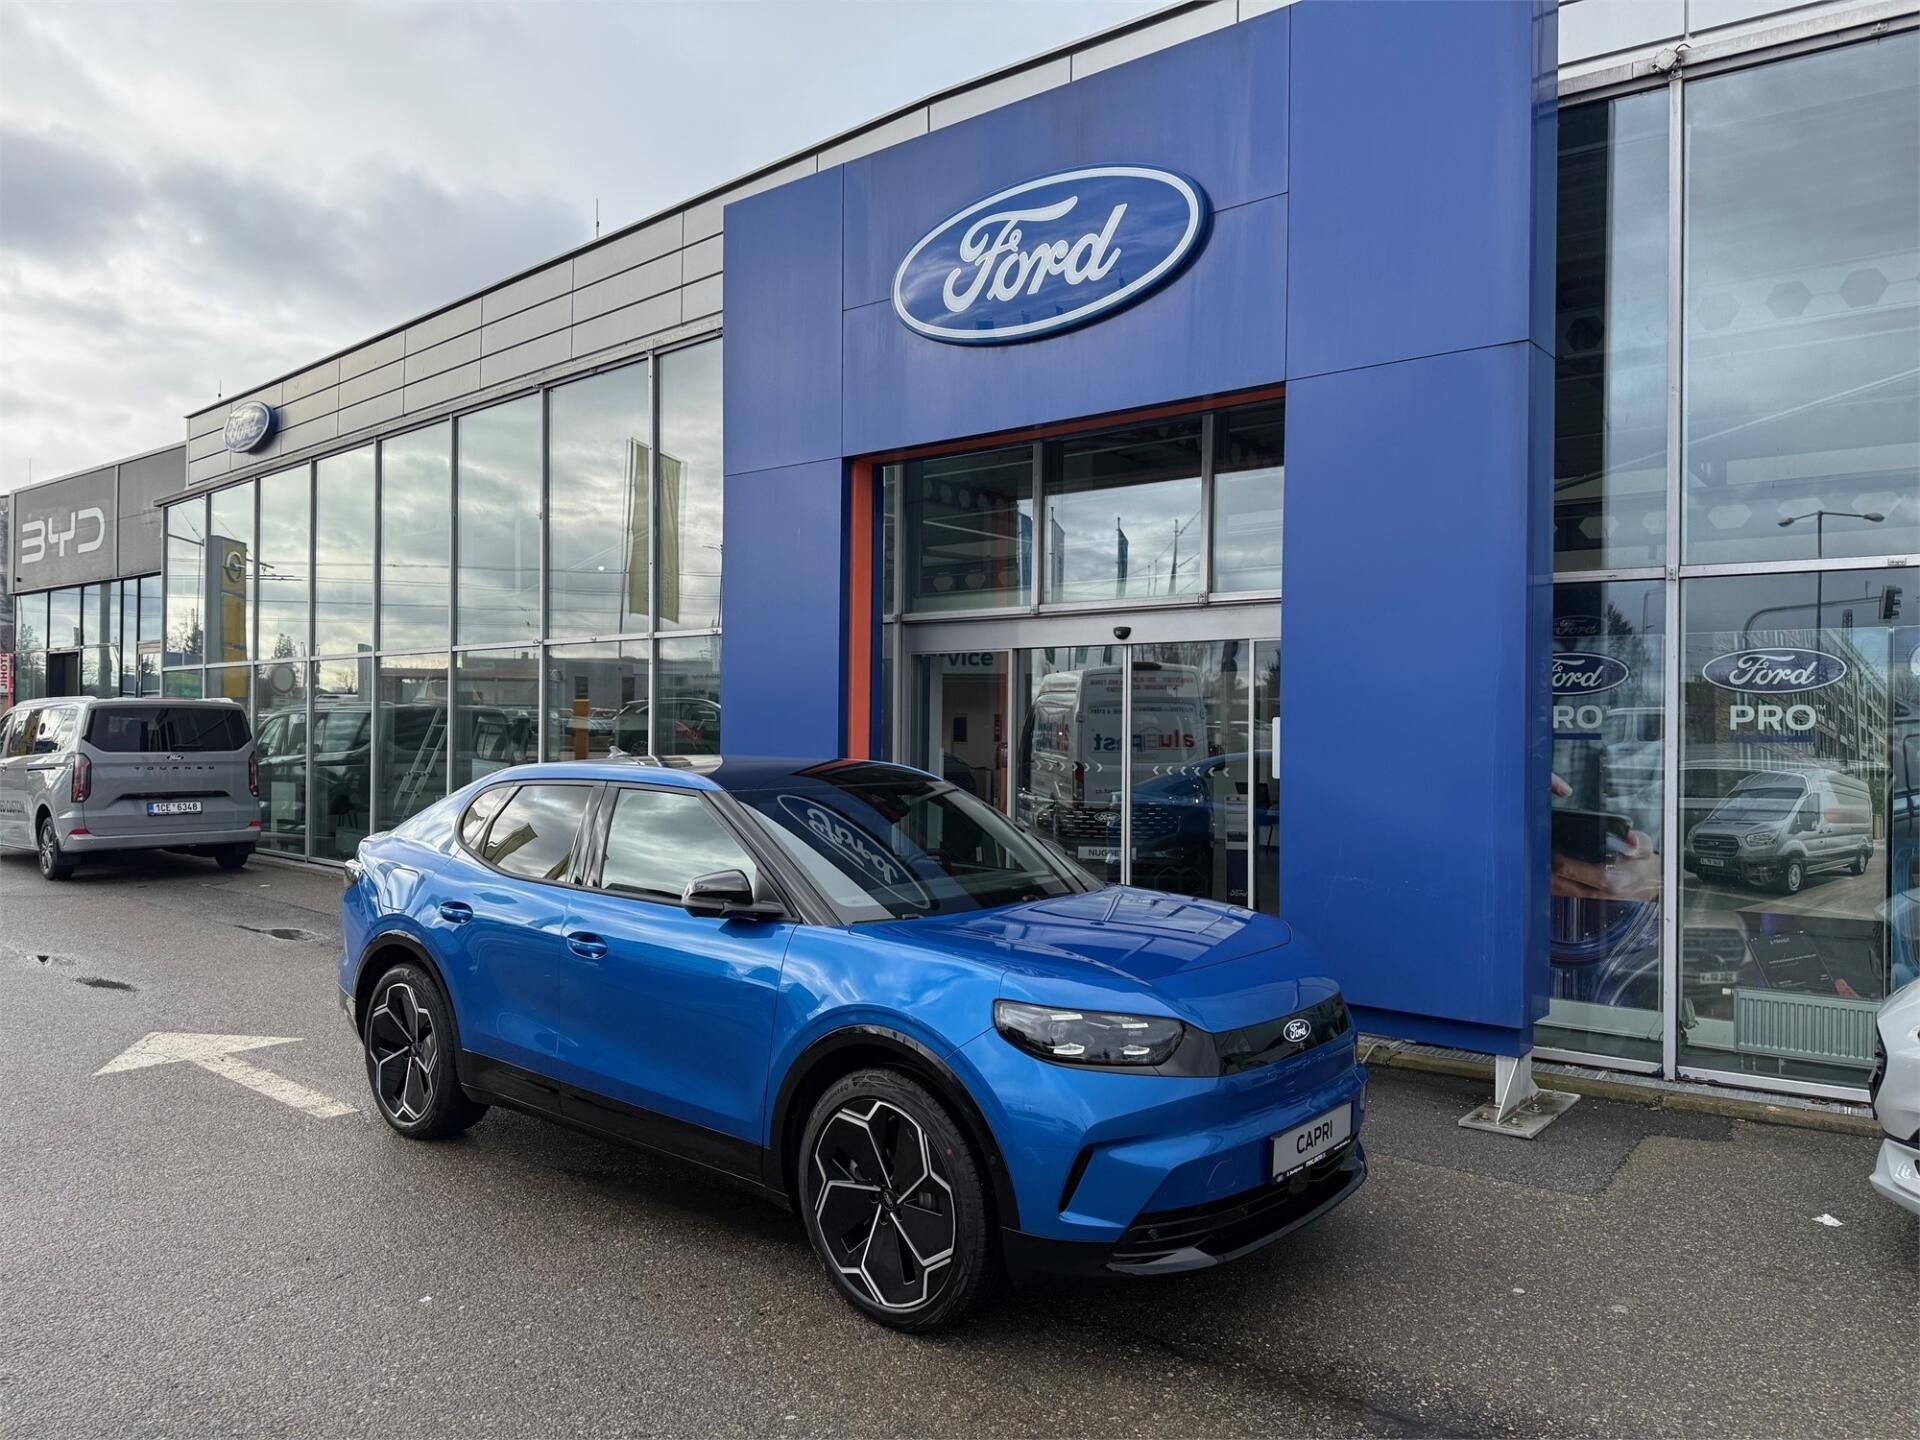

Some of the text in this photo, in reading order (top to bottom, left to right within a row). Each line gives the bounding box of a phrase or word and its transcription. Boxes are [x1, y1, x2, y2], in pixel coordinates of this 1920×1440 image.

[942, 195, 1128, 313] Ford
[21, 506, 105, 564] BYD
[1729, 654, 1818, 685] Ford
[1553, 704, 1603, 729] RO
[1290, 1022, 1306, 1040] Ford
[1296, 1119, 1333, 1154] CAPRI
